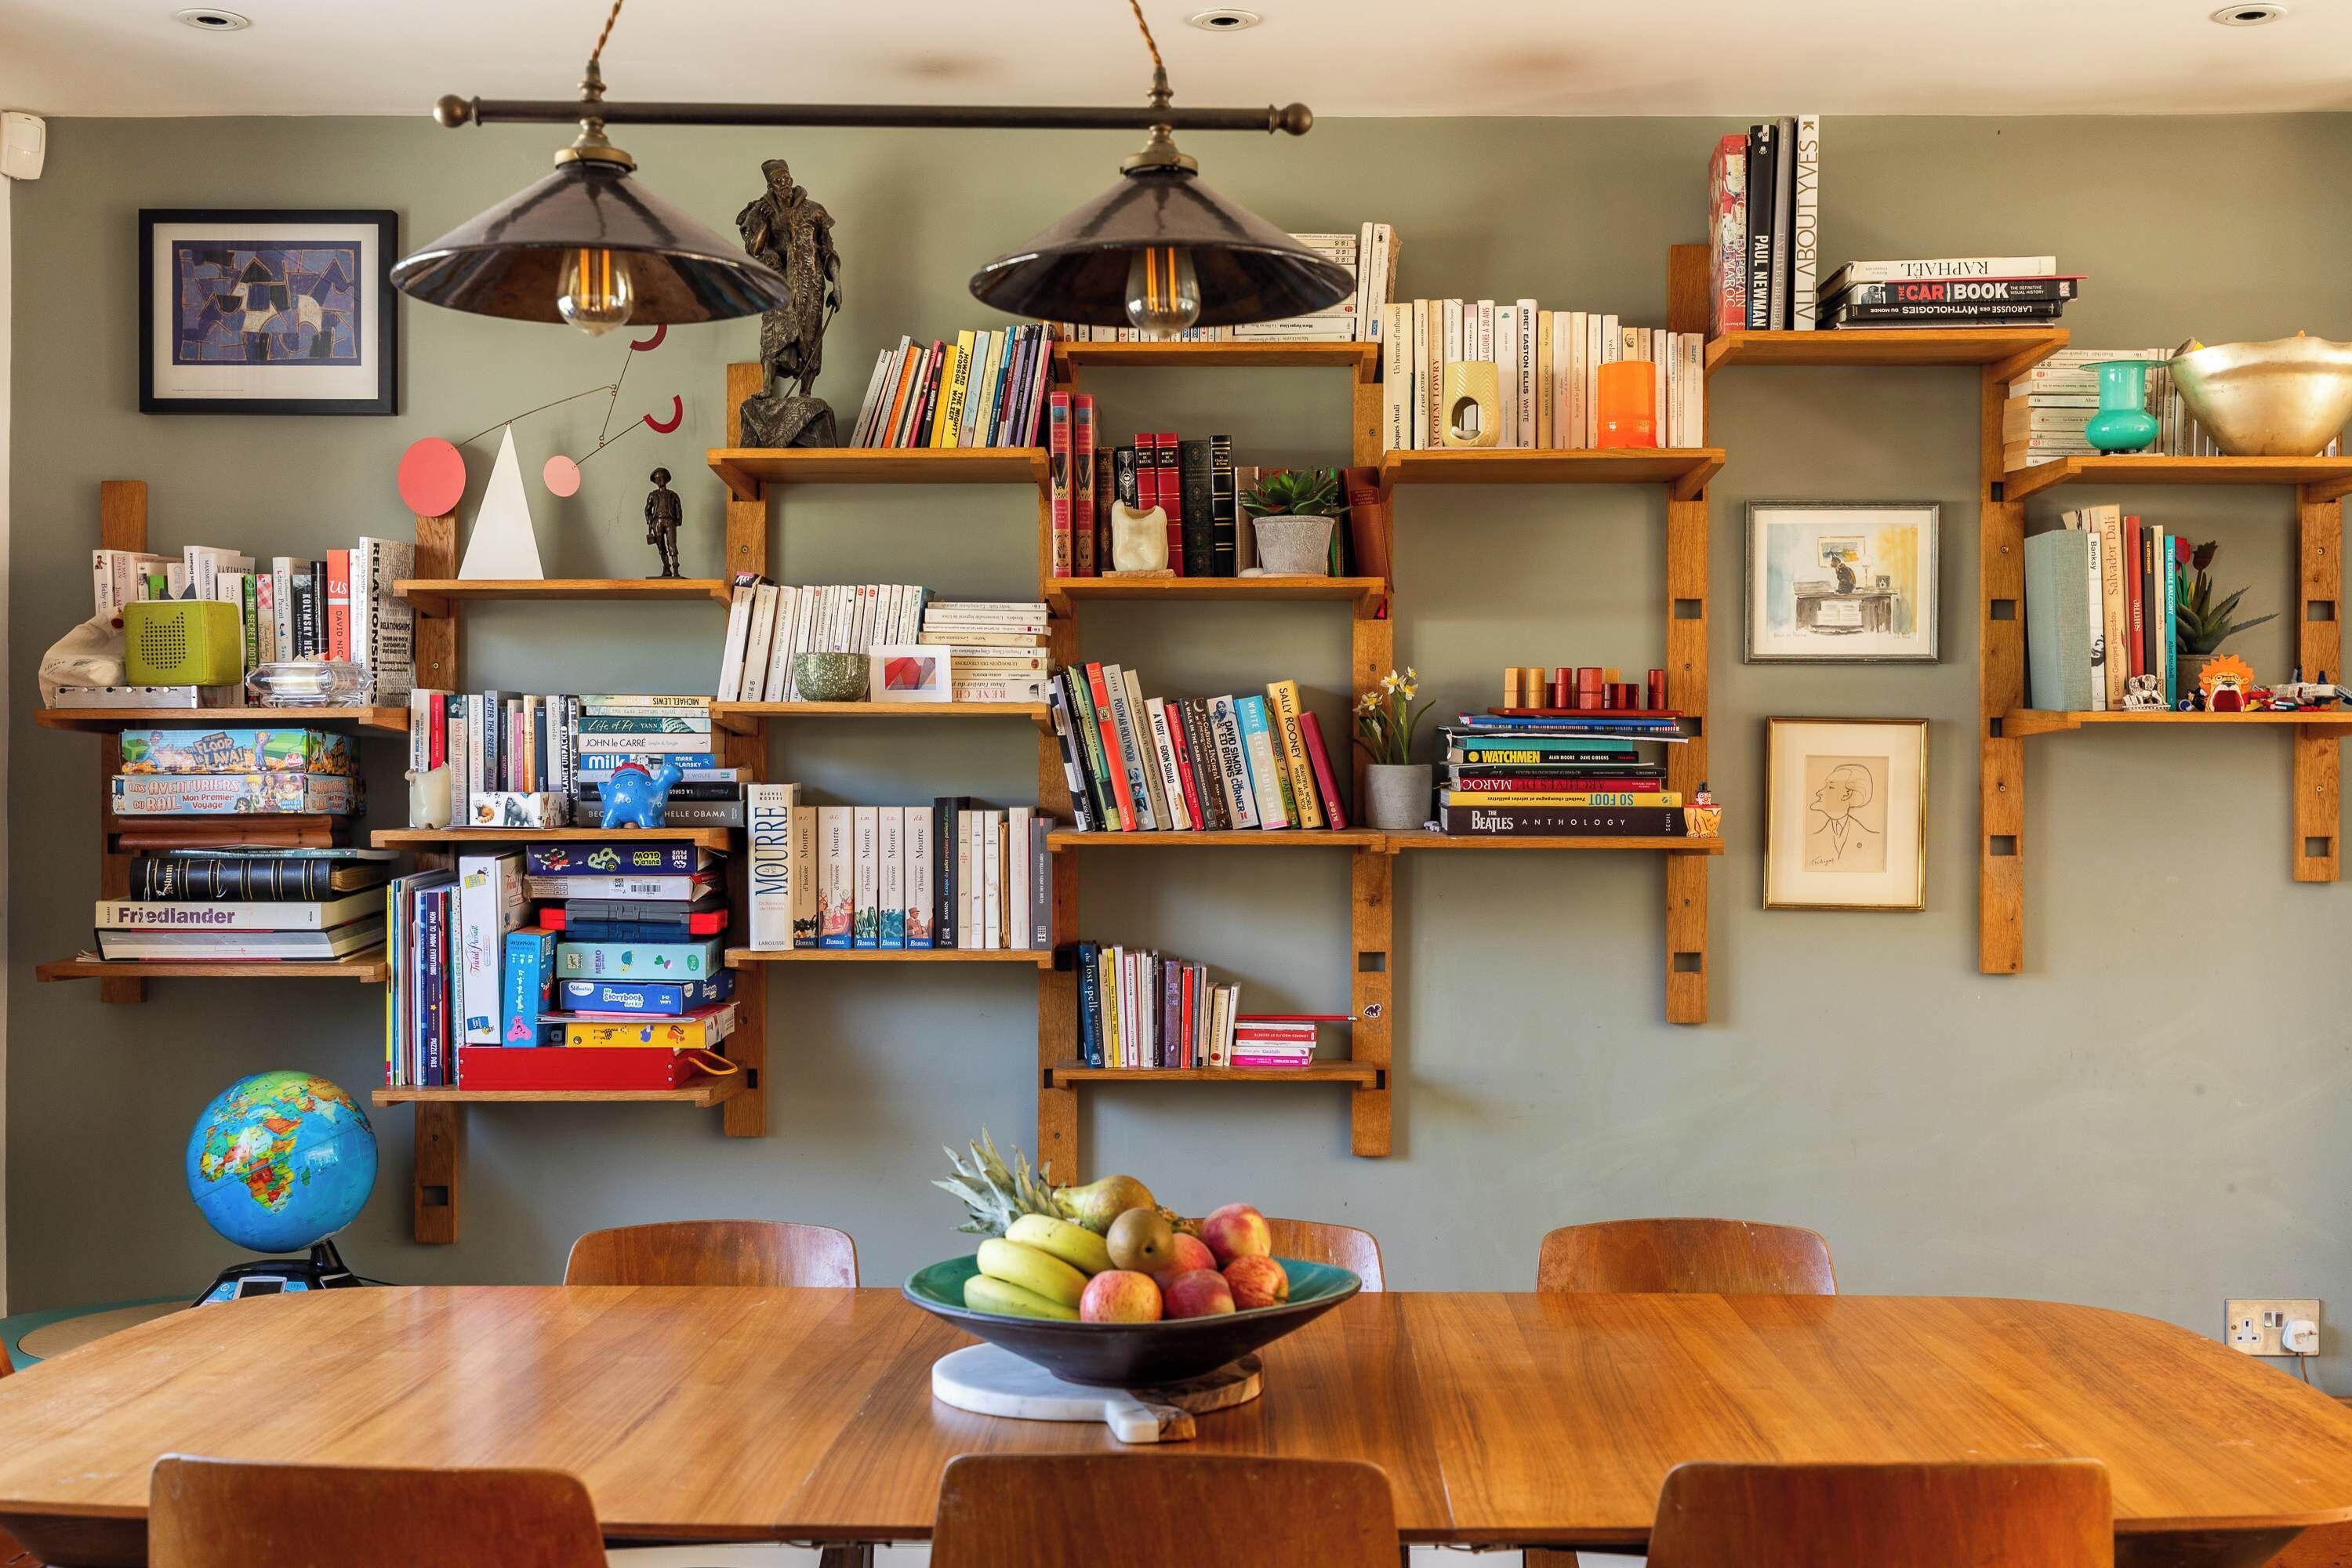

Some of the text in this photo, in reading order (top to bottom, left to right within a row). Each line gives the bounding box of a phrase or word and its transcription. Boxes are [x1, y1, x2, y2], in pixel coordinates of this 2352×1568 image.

[1795, 140, 1818, 320] ALL ABOUT YVES
[1754, 235, 1769, 267] PAUL
[1900, 260, 1989, 279] RAPHAËL
[1724, 259, 1736, 307] MAROC
[1906, 285, 1944, 301] CAR
[1953, 282, 2009, 300] BOOK
[1752, 270, 1769, 327] NEWMAN
[1902, 305, 1978, 314] MYTHOLOGIES
[1992, 305, 2032, 314] LAROUSSE
[1483, 319, 1490, 328] 20
[1483, 354, 1490, 362] LA
[960, 353, 970, 387] HOWARD
[1393, 366, 1401, 375] Un
[949, 344, 965, 422] JACOBSON WALZER
[951, 405, 962, 439] MIGHTY
[1432, 402, 1440, 447] ALCOLM
[1392, 424, 1401, 450] Jacques
[2106, 545, 2119, 597] Salvador
[328, 579, 347, 595] Us
[245, 598, 254, 613] THE
[302, 593, 312, 637] KOLYMSKY
[246, 614, 256, 641] SECRET
[370, 542, 381, 706] RELATIONSHIPS
[379, 622, 411, 632] RELATIONSHIPS
[2113, 644, 2122, 673] Georges
[486, 697, 495, 718] AFTER
[652, 697, 699, 706] MICHAEL LEWIS
[588, 719, 608, 731] Life
[612, 718, 620, 731] of
[1109, 672, 1136, 763] CASPER POSTWAR HOLLYWOOD
[1155, 719, 1165, 735] VISIT
[1279, 687, 1302, 760] SALLY ROONEY
[197, 738, 234, 754] FLOOR
[486, 733, 495, 758] FREEZE
[585, 737, 647, 747] JOHN le CARRÉ
[1218, 733, 1228, 746] ED
[1225, 720, 1243, 775] DAVID SIMON
[561, 726, 570, 794] PLANET UNPACKED
[588, 755, 626, 769] milk
[1160, 745, 1170, 760] GOON
[1221, 747, 1236, 779] BURNS
[1247, 701, 1278, 822] WHITE TEETH ZADIE SMITH
[1481, 750, 1541, 764] WATCHMEN
[1163, 760, 1174, 784] SQUAD
[1294, 767, 1303, 786] WHERE
[129, 779, 240, 795] LES AVENTURIERS
[1298, 764, 1313, 811] BEAUTIFUL WORLD
[1461, 778, 1513, 790] MAROC
[1541, 777, 1606, 791] ARCHIVES
[132, 797, 183, 813] DU RAIL
[182, 793, 234, 803] Mon Premier
[192, 801, 223, 811] Voyage
[1230, 779, 1246, 813] CORNER
[1588, 792, 1617, 806] FOOT
[1619, 792, 1634, 806] SO
[1471, 810, 1626, 833] BEATLES ANTHOLOGY
[753, 806, 789, 896] MOURRE
[800, 828, 808, 859] Mourre
[831, 826, 840, 858] Mourre
[862, 828, 870, 859] Mourre
[887, 828, 896, 859] Mourre
[915, 828, 924, 859] Mourre
[118, 907, 235, 924] Friedlander
[1085, 964, 1095, 982] lost
[603, 990, 644, 1004] Storybook
[1084, 985, 1098, 1013] spells
